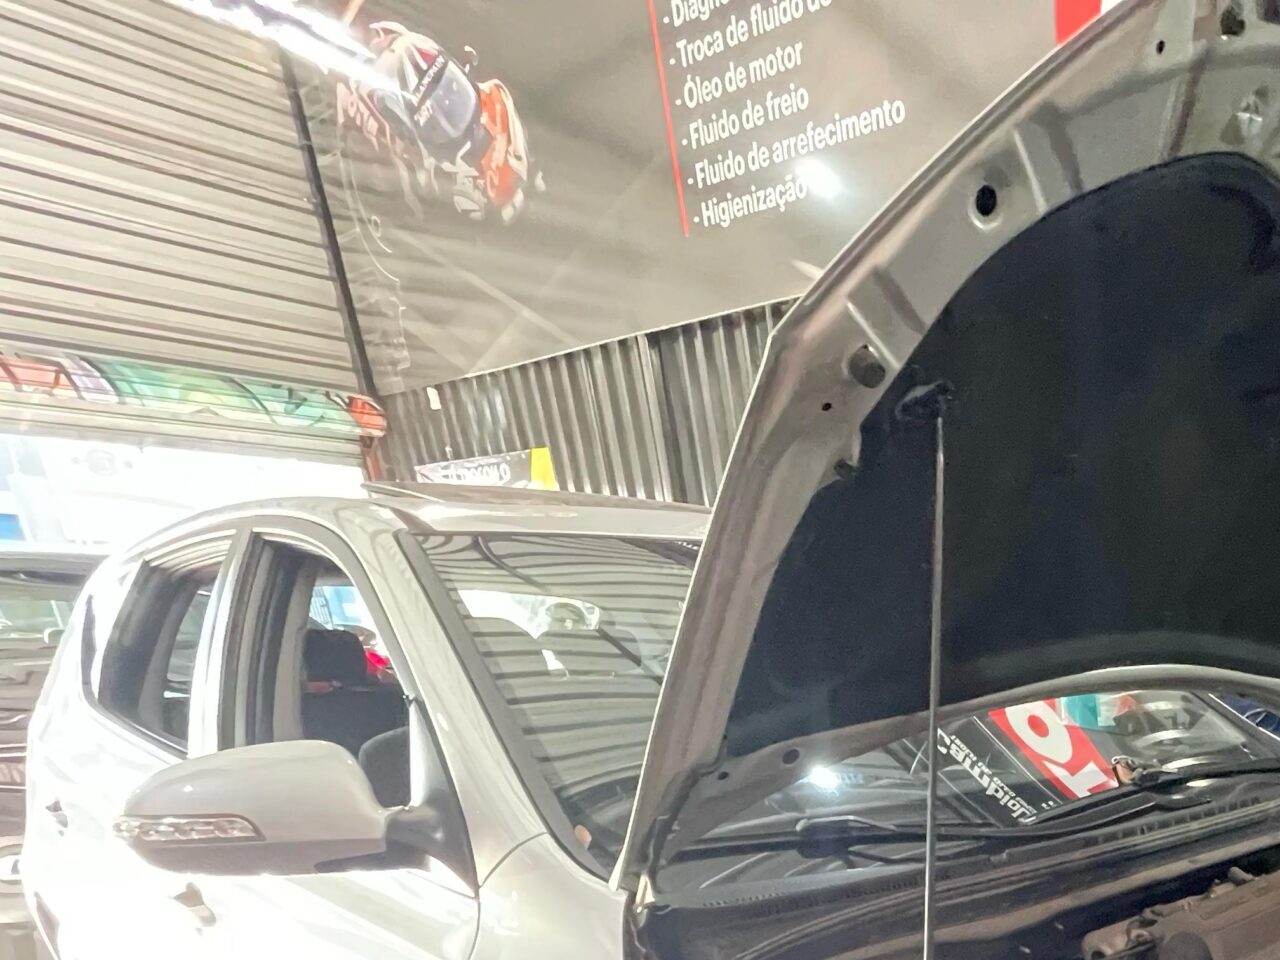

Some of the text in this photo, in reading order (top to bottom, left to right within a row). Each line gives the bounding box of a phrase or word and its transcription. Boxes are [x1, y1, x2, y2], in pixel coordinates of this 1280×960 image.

[676, 38, 724, 67] Troca
[726, 15, 749, 47] de
[750, 0, 803, 37] fluido
[684, 42, 803, 108] Óleo de motor
[689, 83, 809, 149] Fluido de freio
[695, 99, 906, 188] Fluido de arrefecimento
[701, 174, 808, 228] Higienização
